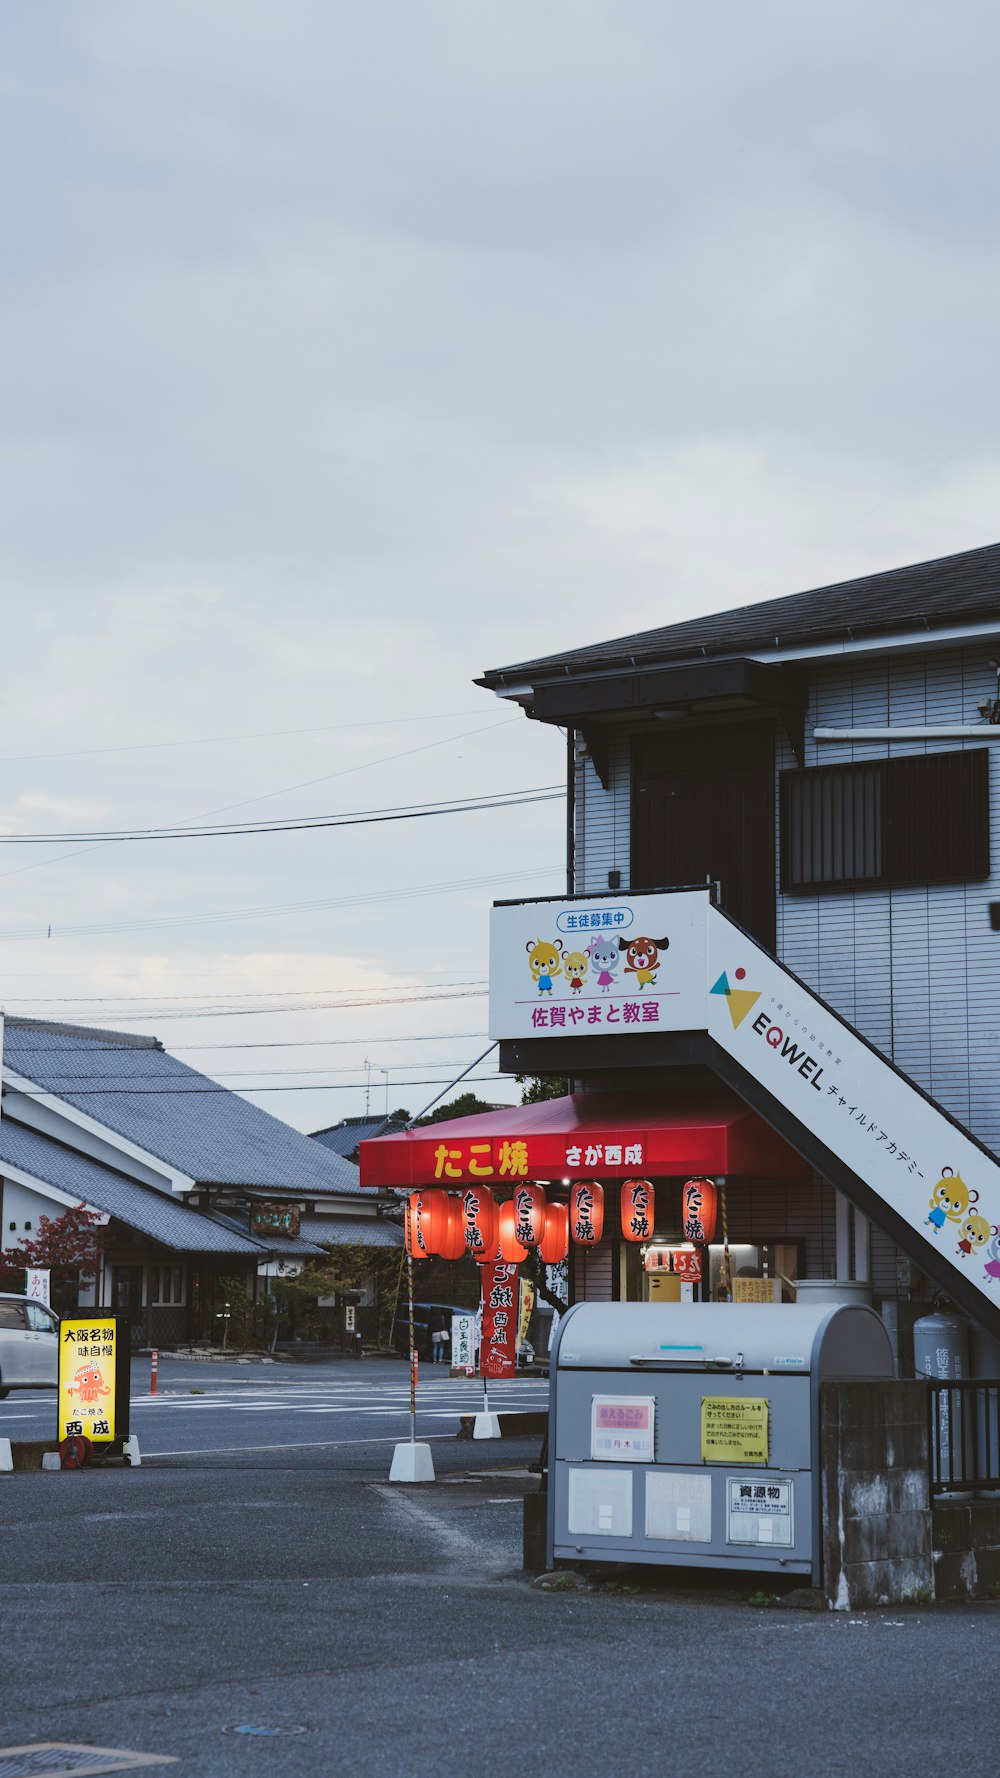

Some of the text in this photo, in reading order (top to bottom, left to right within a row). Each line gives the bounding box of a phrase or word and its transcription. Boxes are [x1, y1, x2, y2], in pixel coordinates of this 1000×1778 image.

[566, 911, 625, 929] 生徒募集中
[531, 1001, 660, 1028] 佐賀やまと教室
[751, 1012, 924, 1178] EQWEL チャイルドアカデミー
[434, 1141, 529, 1179] たこ焼
[565, 1143, 643, 1167] さが西成
[464, 1190, 483, 1247] たこ焼
[516, 1189, 535, 1242] たこ焼
[575, 1186, 595, 1241] たこ焼
[630, 1184, 650, 1238] たこ焼
[685, 1185, 705, 1240] たこ焼
[64, 1328, 114, 1342] 大阪名物
[78, 1345, 113, 1357] 味自慢
[72, 1408, 104, 1416] たこ焼き
[600, 1407, 643, 1420] えるごみ
[740, 1485, 780, 1499] 資源物
